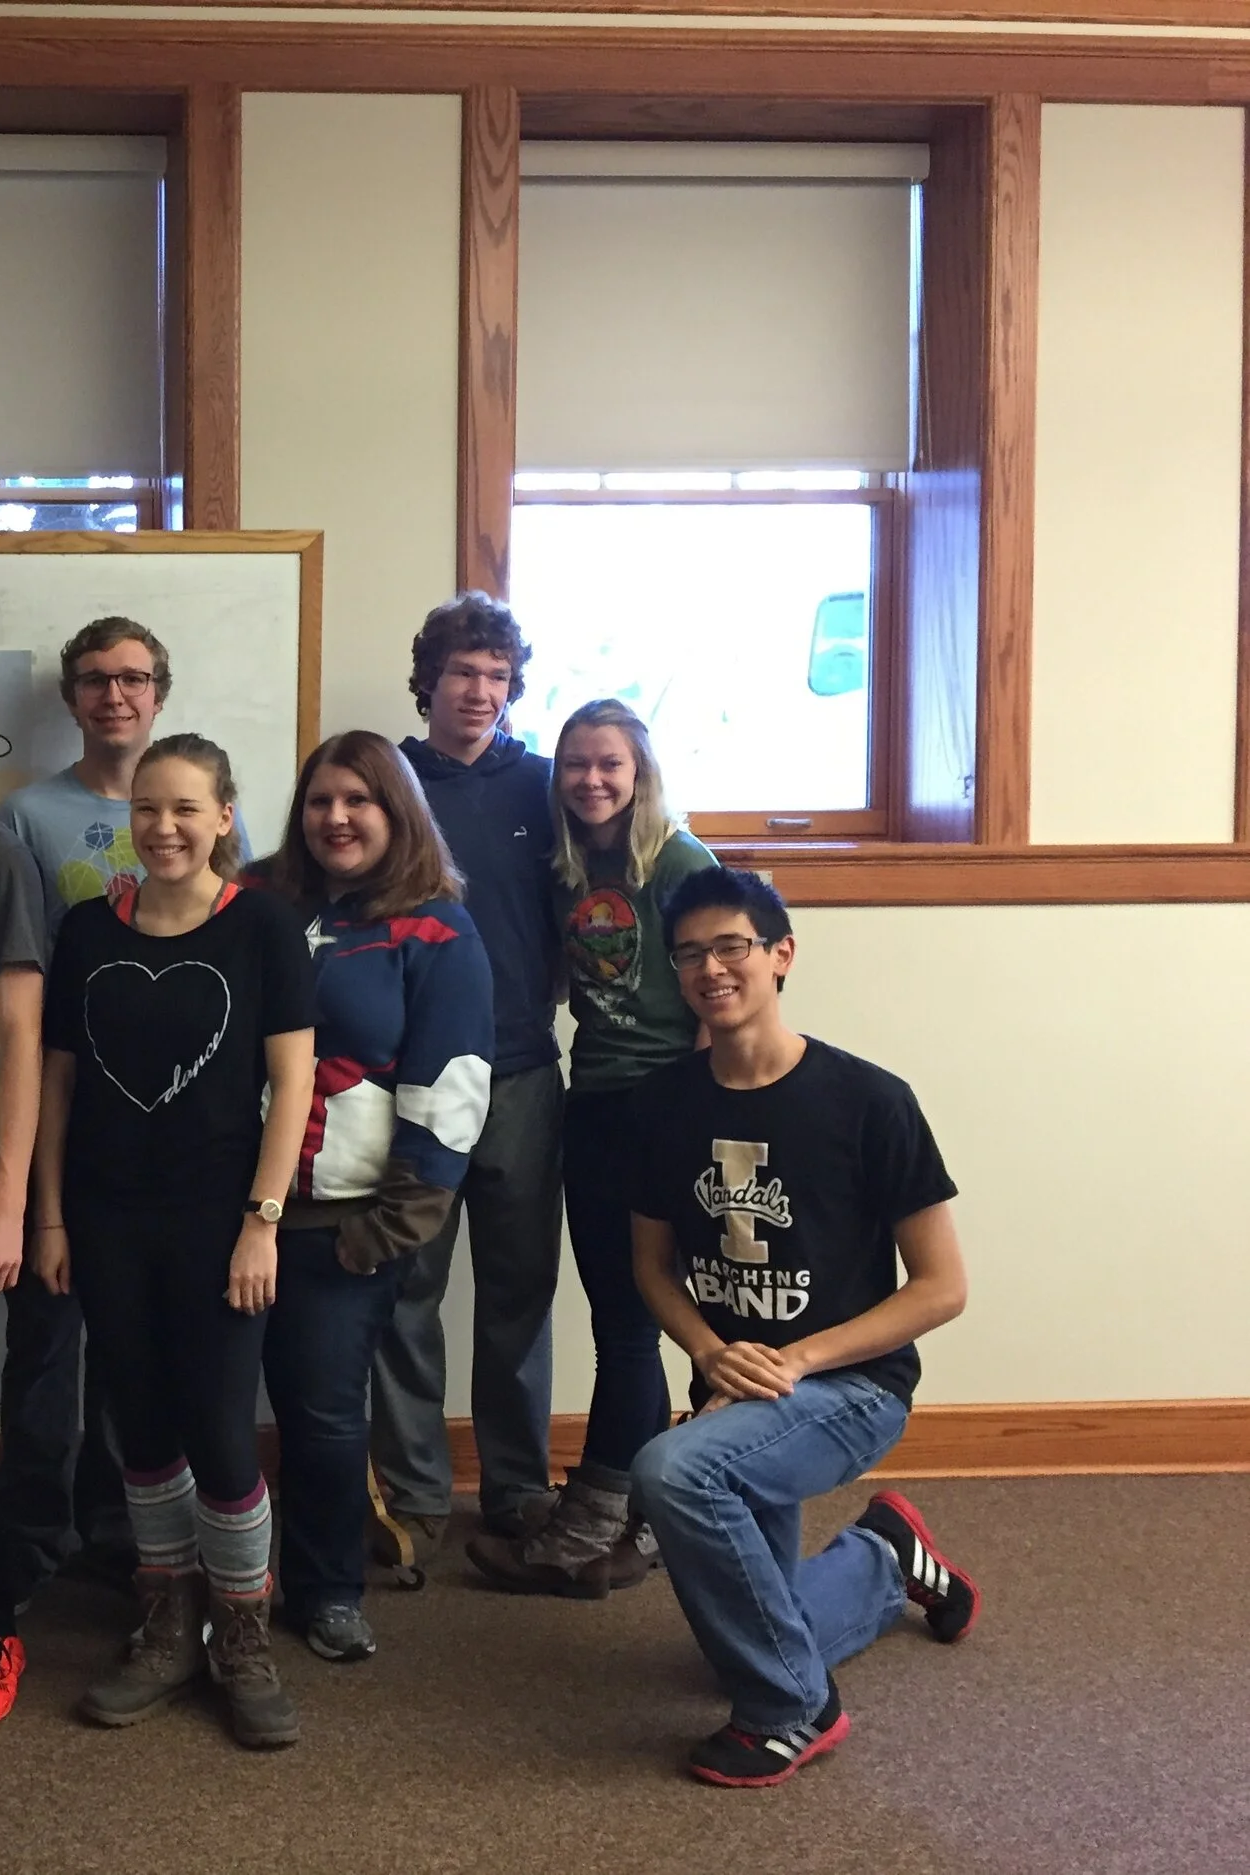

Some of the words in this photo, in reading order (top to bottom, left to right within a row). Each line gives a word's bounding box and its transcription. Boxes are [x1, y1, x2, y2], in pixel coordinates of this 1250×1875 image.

[164, 1031, 220, 1104] dance
[695, 1168, 793, 1228] Vandals
[692, 1256, 811, 1288] MARCHING
[694, 1272, 810, 1322] BAND
